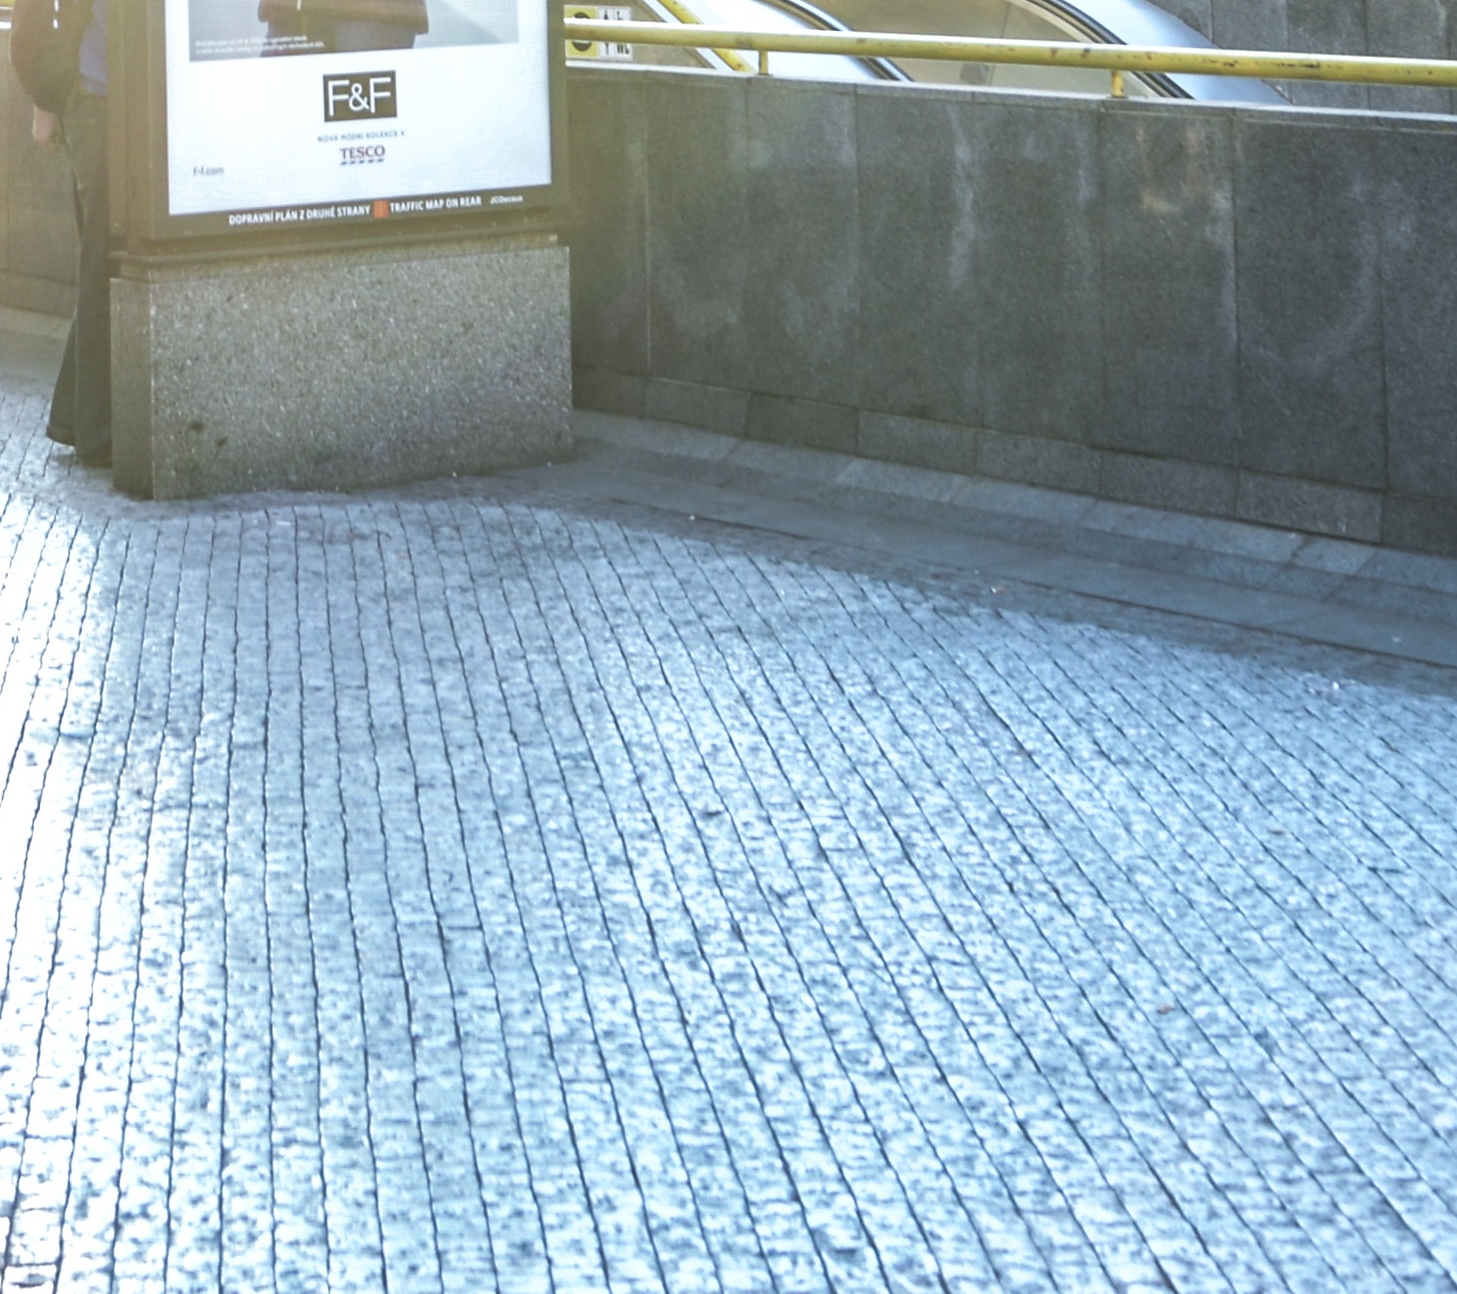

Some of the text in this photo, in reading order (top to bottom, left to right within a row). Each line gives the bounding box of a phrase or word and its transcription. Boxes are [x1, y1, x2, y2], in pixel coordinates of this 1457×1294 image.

[327, 76, 392, 117] F&F
[339, 144, 386, 162] TESCO
[228, 195, 482, 226] DOPRAVNÍ PLÁN Z DRUHÉ STRANY TRAFFIC MAP ON REAR
